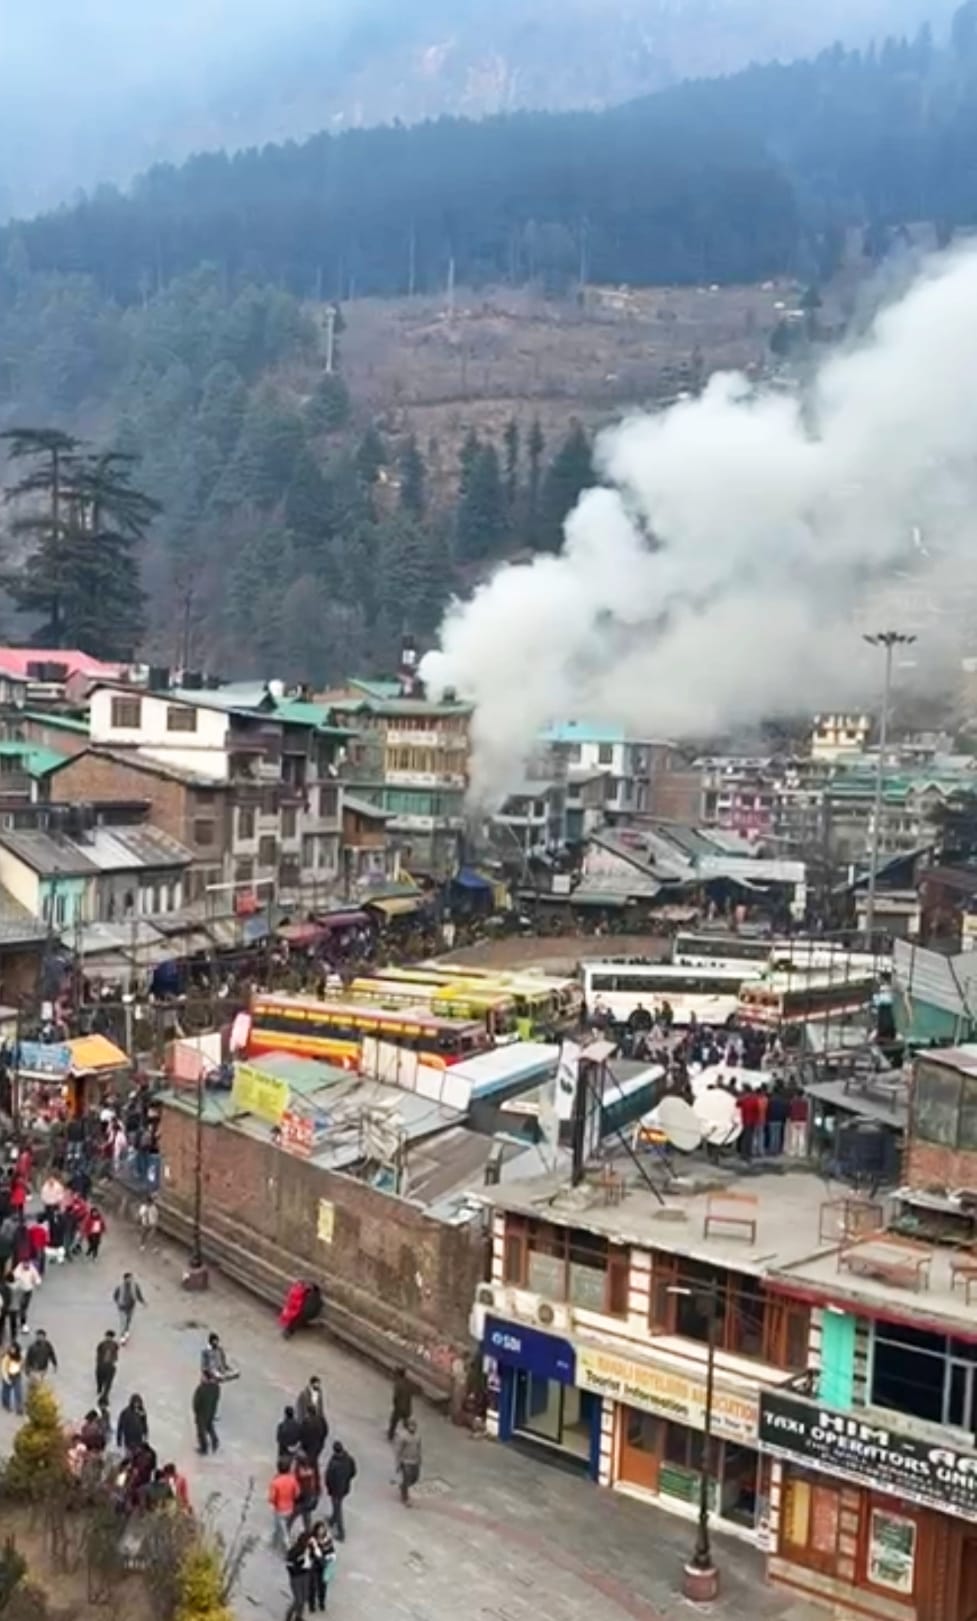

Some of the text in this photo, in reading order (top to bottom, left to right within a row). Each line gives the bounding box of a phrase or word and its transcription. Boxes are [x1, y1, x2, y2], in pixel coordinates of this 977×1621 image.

[585, 1368, 621, 1393] Tourist
[624, 1382, 689, 1416] Information
[763, 1410, 805, 1435] TAXI
[810, 1426, 930, 1475] OPERATORS
[936, 1467, 977, 1490] UNI
[819, 1411, 889, 1447] HIM
